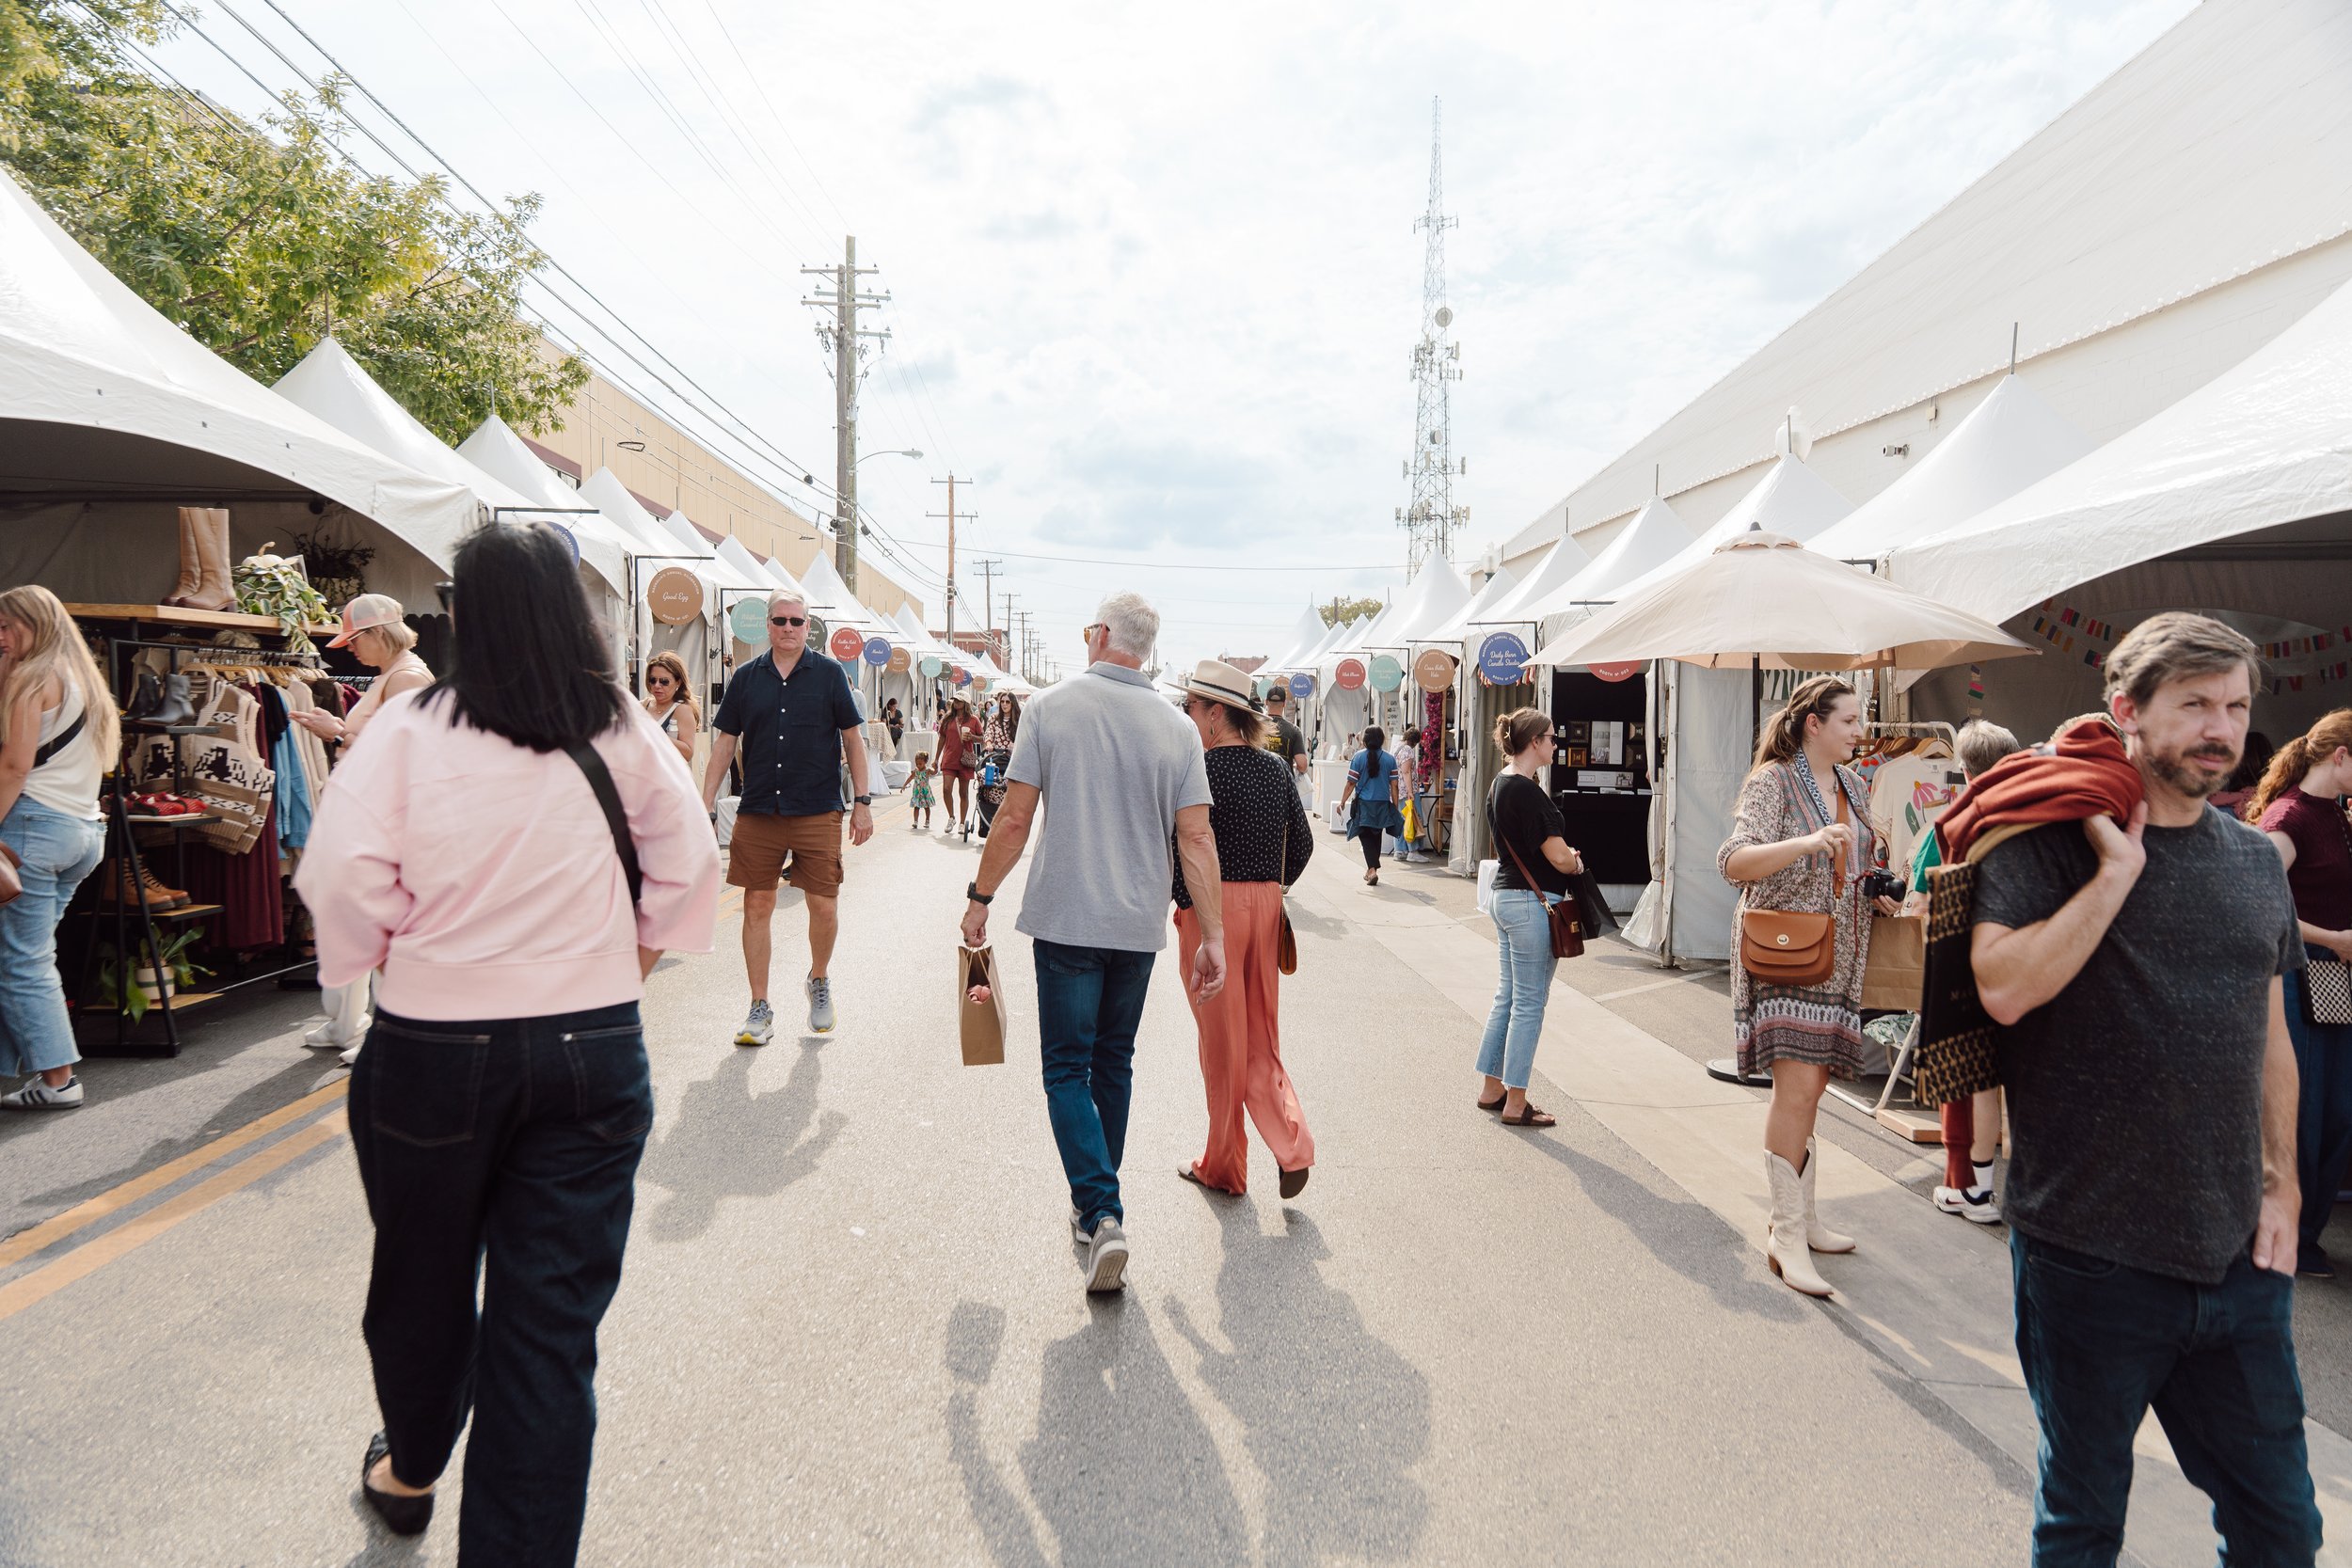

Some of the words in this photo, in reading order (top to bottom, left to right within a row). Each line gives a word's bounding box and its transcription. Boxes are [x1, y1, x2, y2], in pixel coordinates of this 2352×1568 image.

[662, 592, 677, 602] Good
[677, 592, 689, 603] Egg
[1490, 651, 1504, 662] Daily
[1487, 658, 1504, 667] Candle
[1599, 669, 1613, 677] BOOTH
